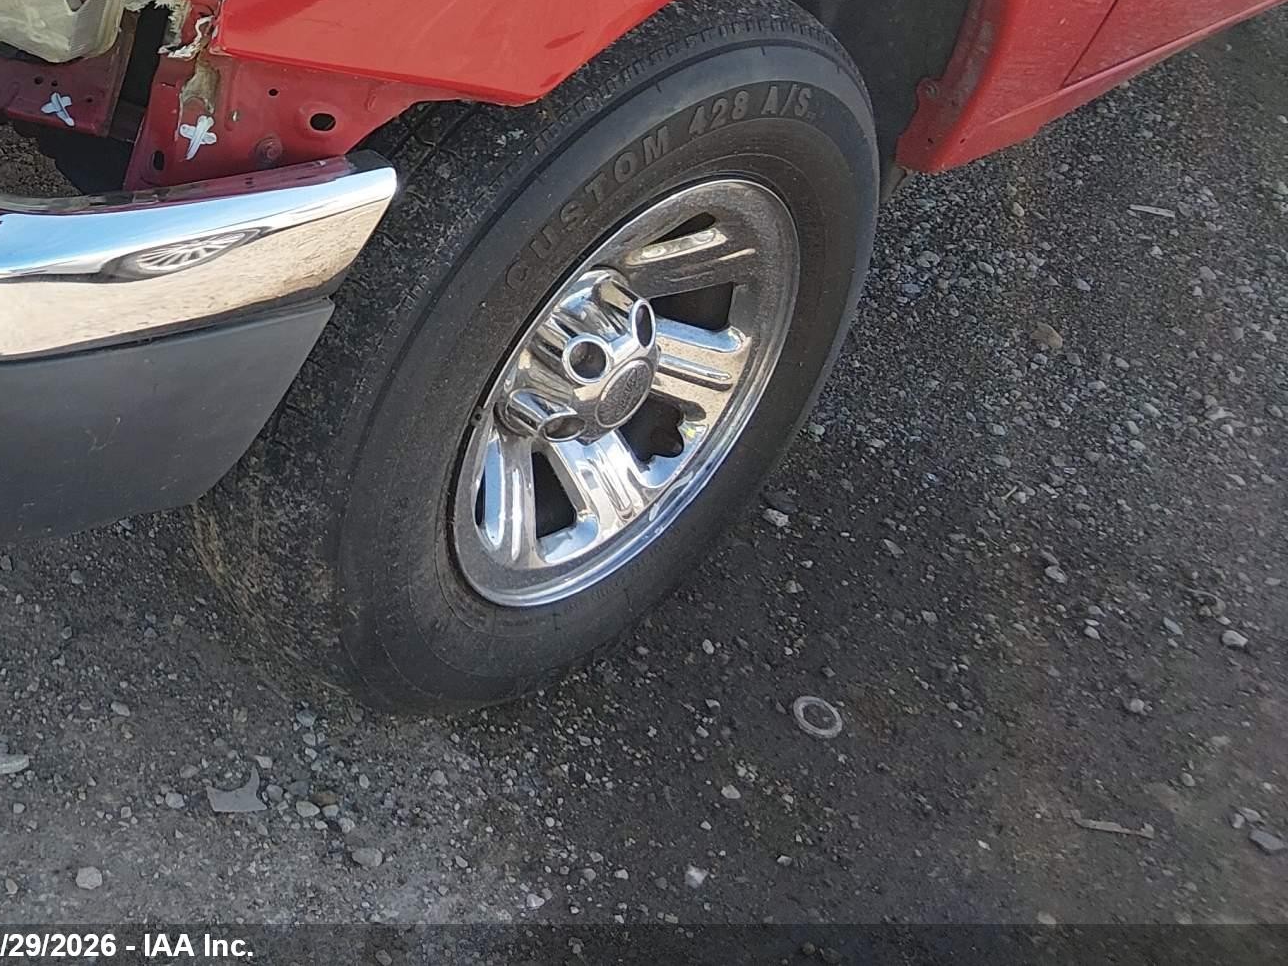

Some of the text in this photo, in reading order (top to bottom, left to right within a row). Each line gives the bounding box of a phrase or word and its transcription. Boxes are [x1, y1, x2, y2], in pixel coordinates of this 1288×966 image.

[505, 84, 813, 289] CUSTOM 428 A/S
